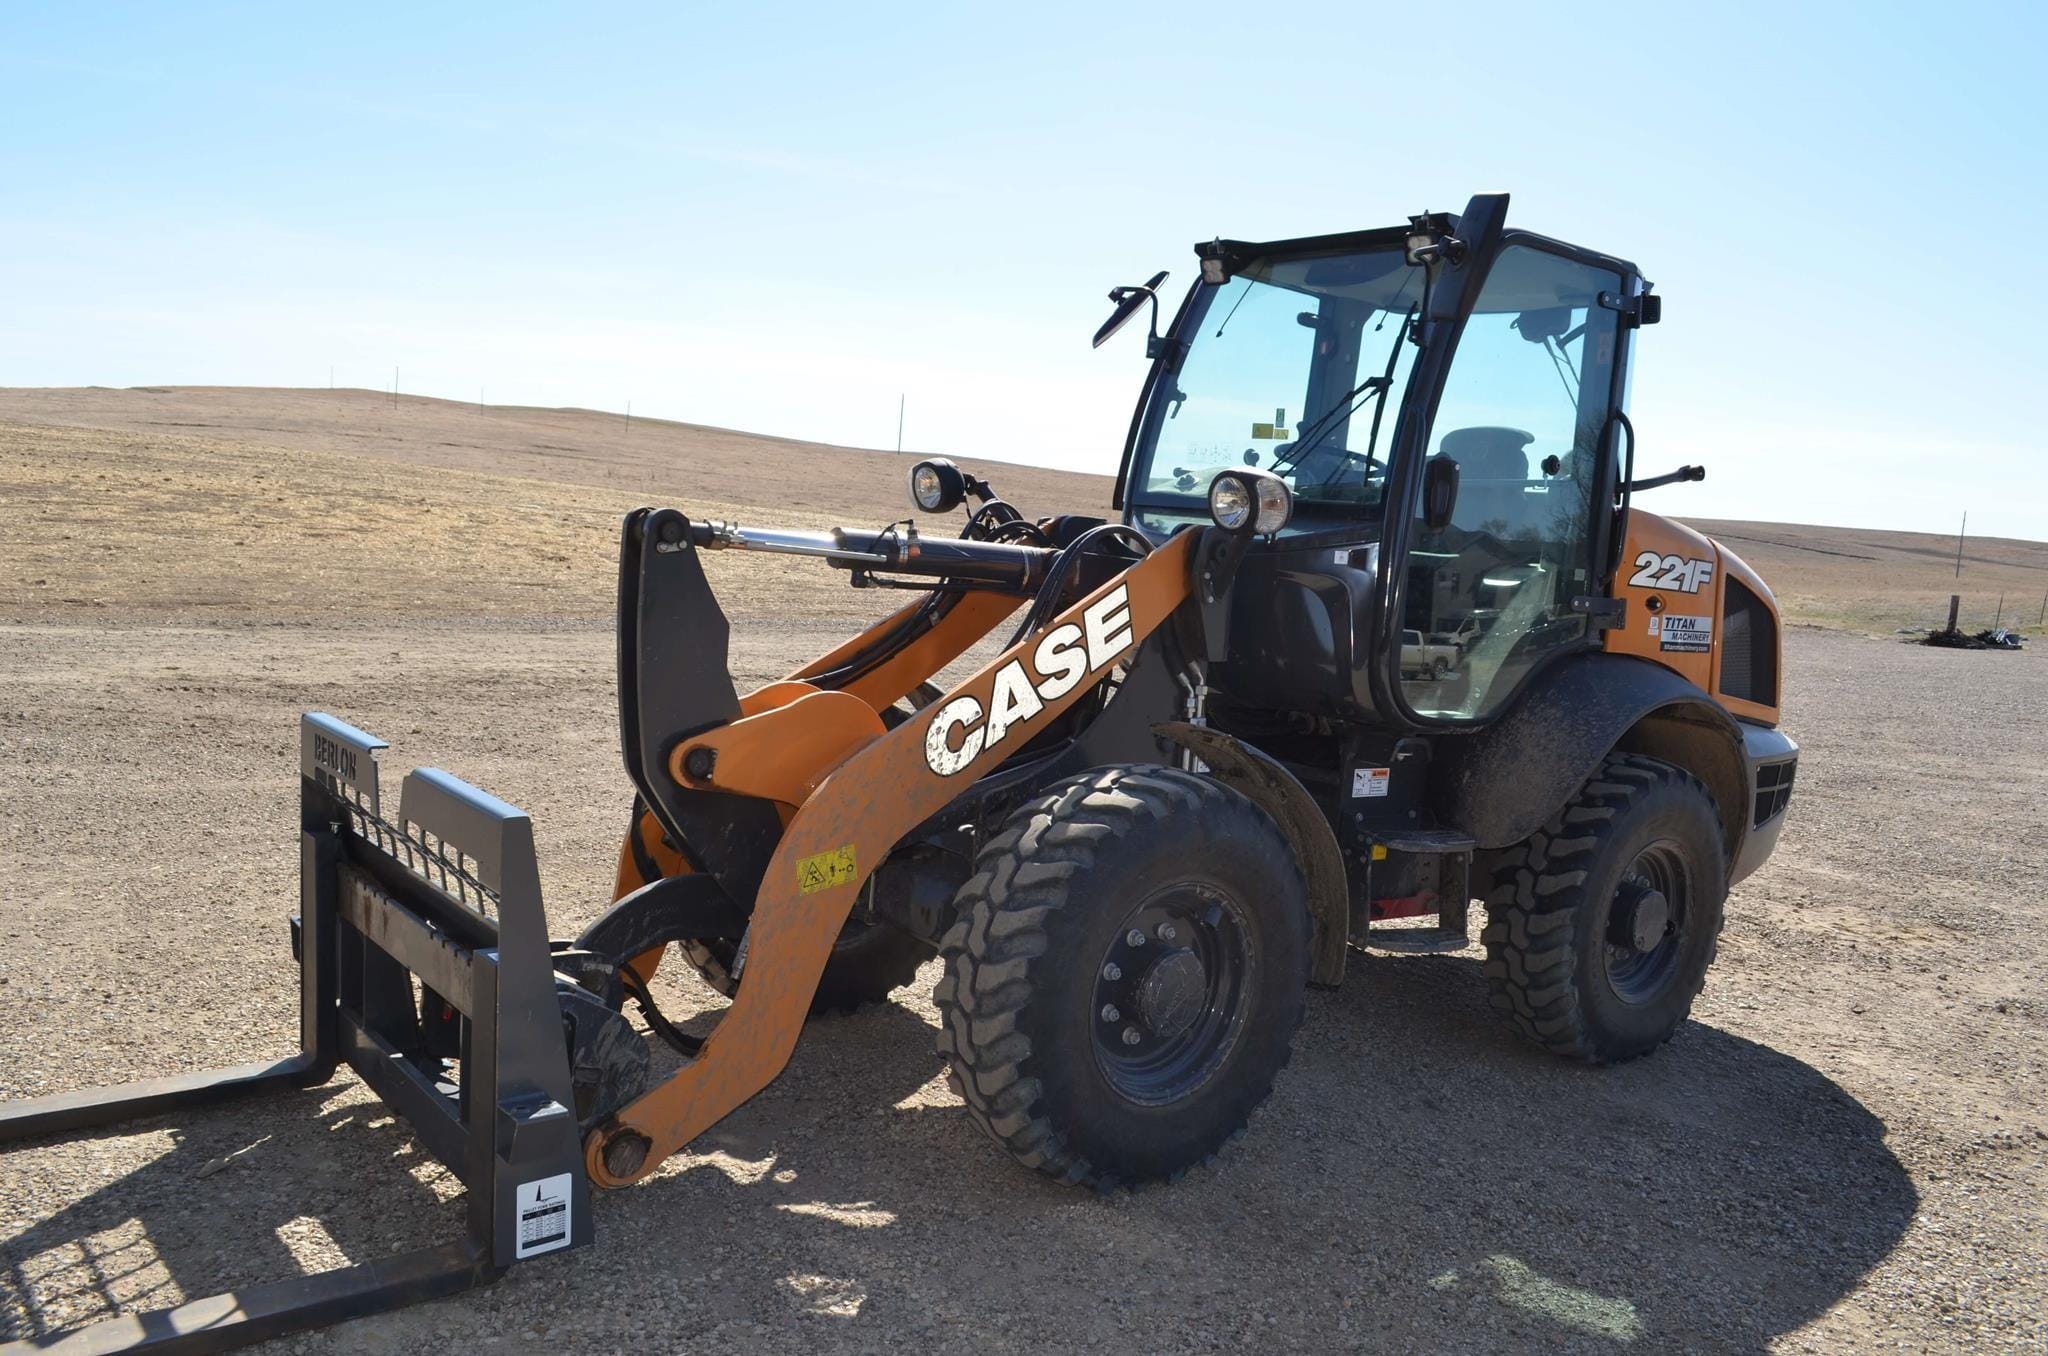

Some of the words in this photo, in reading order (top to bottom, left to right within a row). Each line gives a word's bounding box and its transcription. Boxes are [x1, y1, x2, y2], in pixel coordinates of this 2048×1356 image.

[1628, 551, 1714, 593] 221F
[1665, 617, 1696, 629] TITAN
[1671, 632, 1710, 642] MACHINERY
[925, 582, 1134, 776] CASE
[314, 734, 356, 780] BERLON
